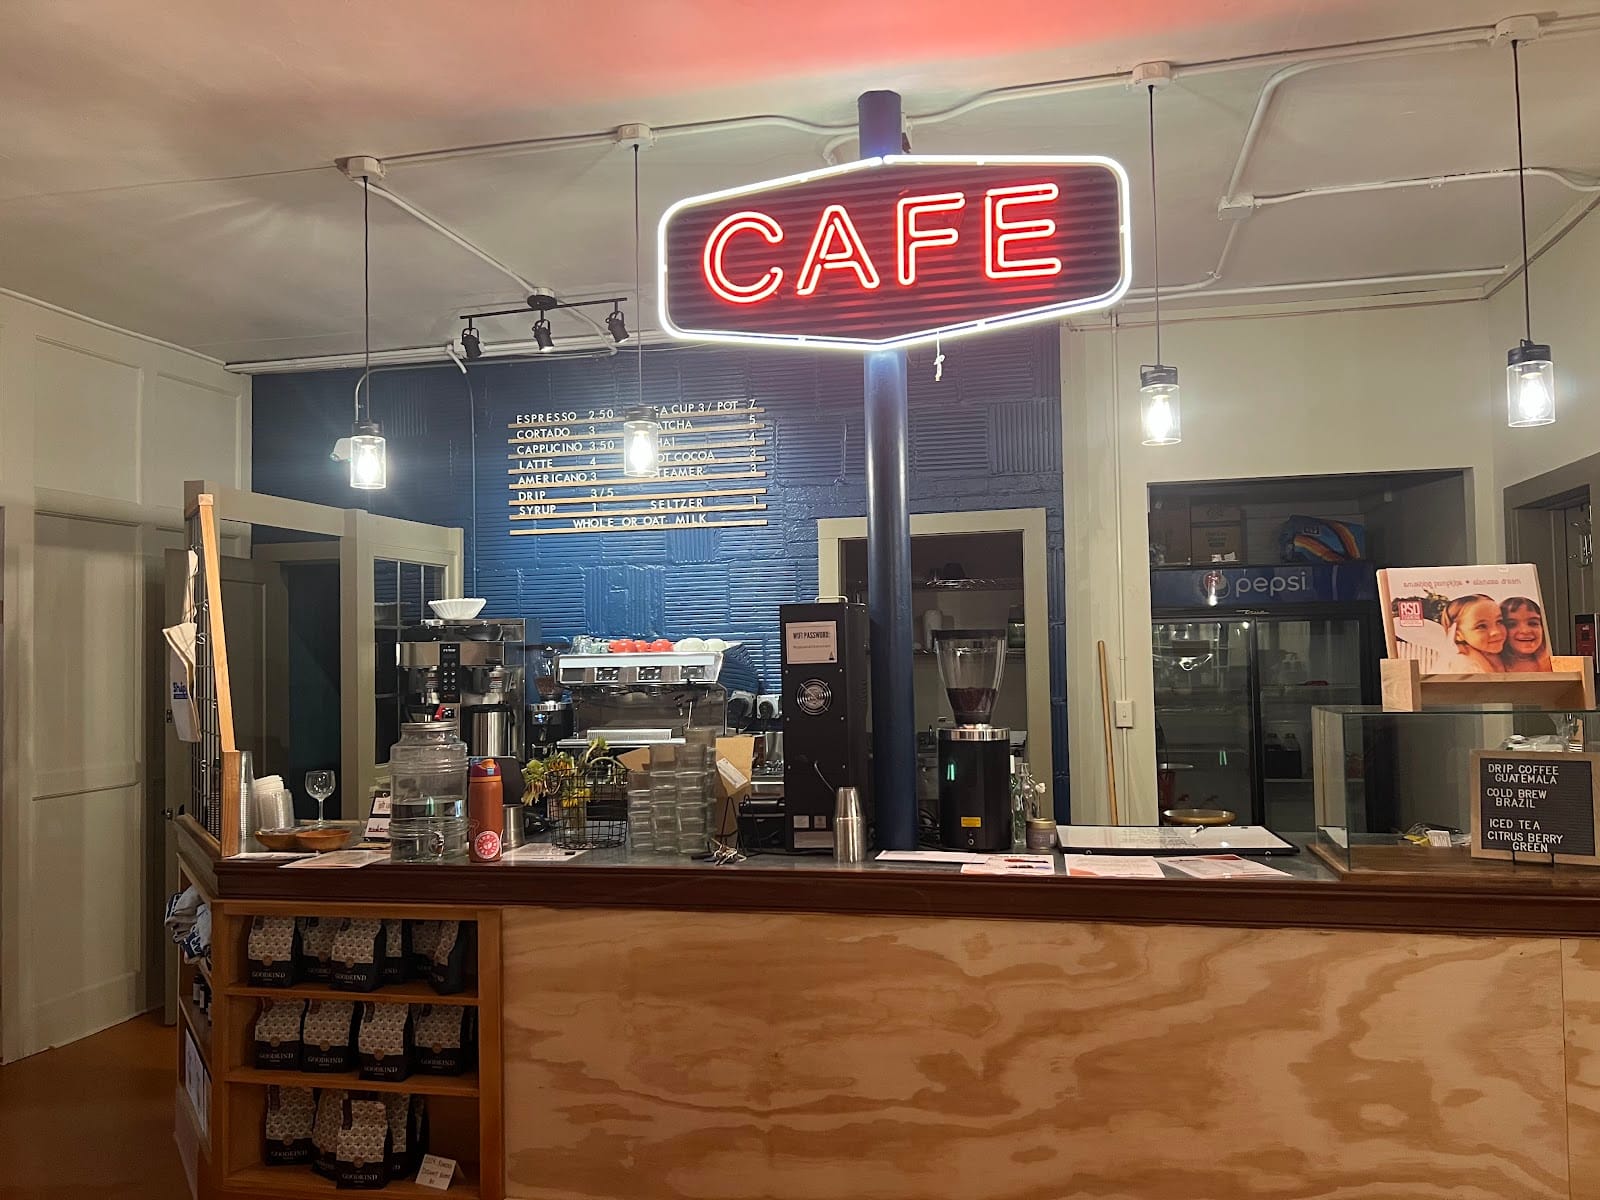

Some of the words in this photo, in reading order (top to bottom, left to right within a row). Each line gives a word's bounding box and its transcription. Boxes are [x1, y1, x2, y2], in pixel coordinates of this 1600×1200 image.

[703, 182, 1062, 304] CAFE
[672, 404, 695, 414] CUP
[717, 400, 738, 410] POT
[749, 399, 757, 409] 7
[516, 411, 577, 424] ESPRESSO
[588, 409, 614, 420] 2.50
[657, 420, 693, 430] ATCHA
[749, 415, 756, 424] 5
[516, 427, 570, 439] CORTADO
[588, 426, 595, 435] 3
[656, 437, 675, 448] HAI
[748, 432, 755, 441] 4
[517, 442, 583, 455] CAPPUCINO
[589, 440, 615, 450] 3.50
[656, 453, 671, 463] OT
[674, 450, 715, 461] COCOA
[750, 448, 757, 457] 3
[519, 459, 553, 469] LATTE
[589, 457, 596, 466] 4
[657, 467, 704, 478] TEAMER
[750, 464, 757, 473] 3
[518, 472, 587, 485] AMERICANO
[590, 472, 597, 481] 3
[518, 490, 546, 501] DRIP
[650, 498, 704, 509] SELTZER
[752, 495, 757, 504] 1
[519, 504, 557, 515] SYRUP
[592, 503, 598, 512] 1
[573, 518, 614, 529] WHOLE
[622, 517, 638, 527] OR
[643, 516, 666, 526] OAT
[675, 513, 706, 524] MILK
[1235, 571, 1306, 597] pepsi
[1400, 602, 1420, 616] RSD
[1488, 764, 1514, 773] DRIP
[1518, 765, 1559, 776] COFFEE
[1495, 773, 1557, 785] GUATEMALA
[1486, 787, 1513, 798] COLD
[1518, 788, 1547, 799] BREW
[1495, 797, 1536, 808] BRAZIL
[1489, 818, 1513, 829] ICED
[1518, 819, 1541, 830] TEA
[1487, 830, 1524, 842] CITRUS
[1528, 832, 1564, 844] BERRY
[1512, 841, 1548, 853] GREEN
